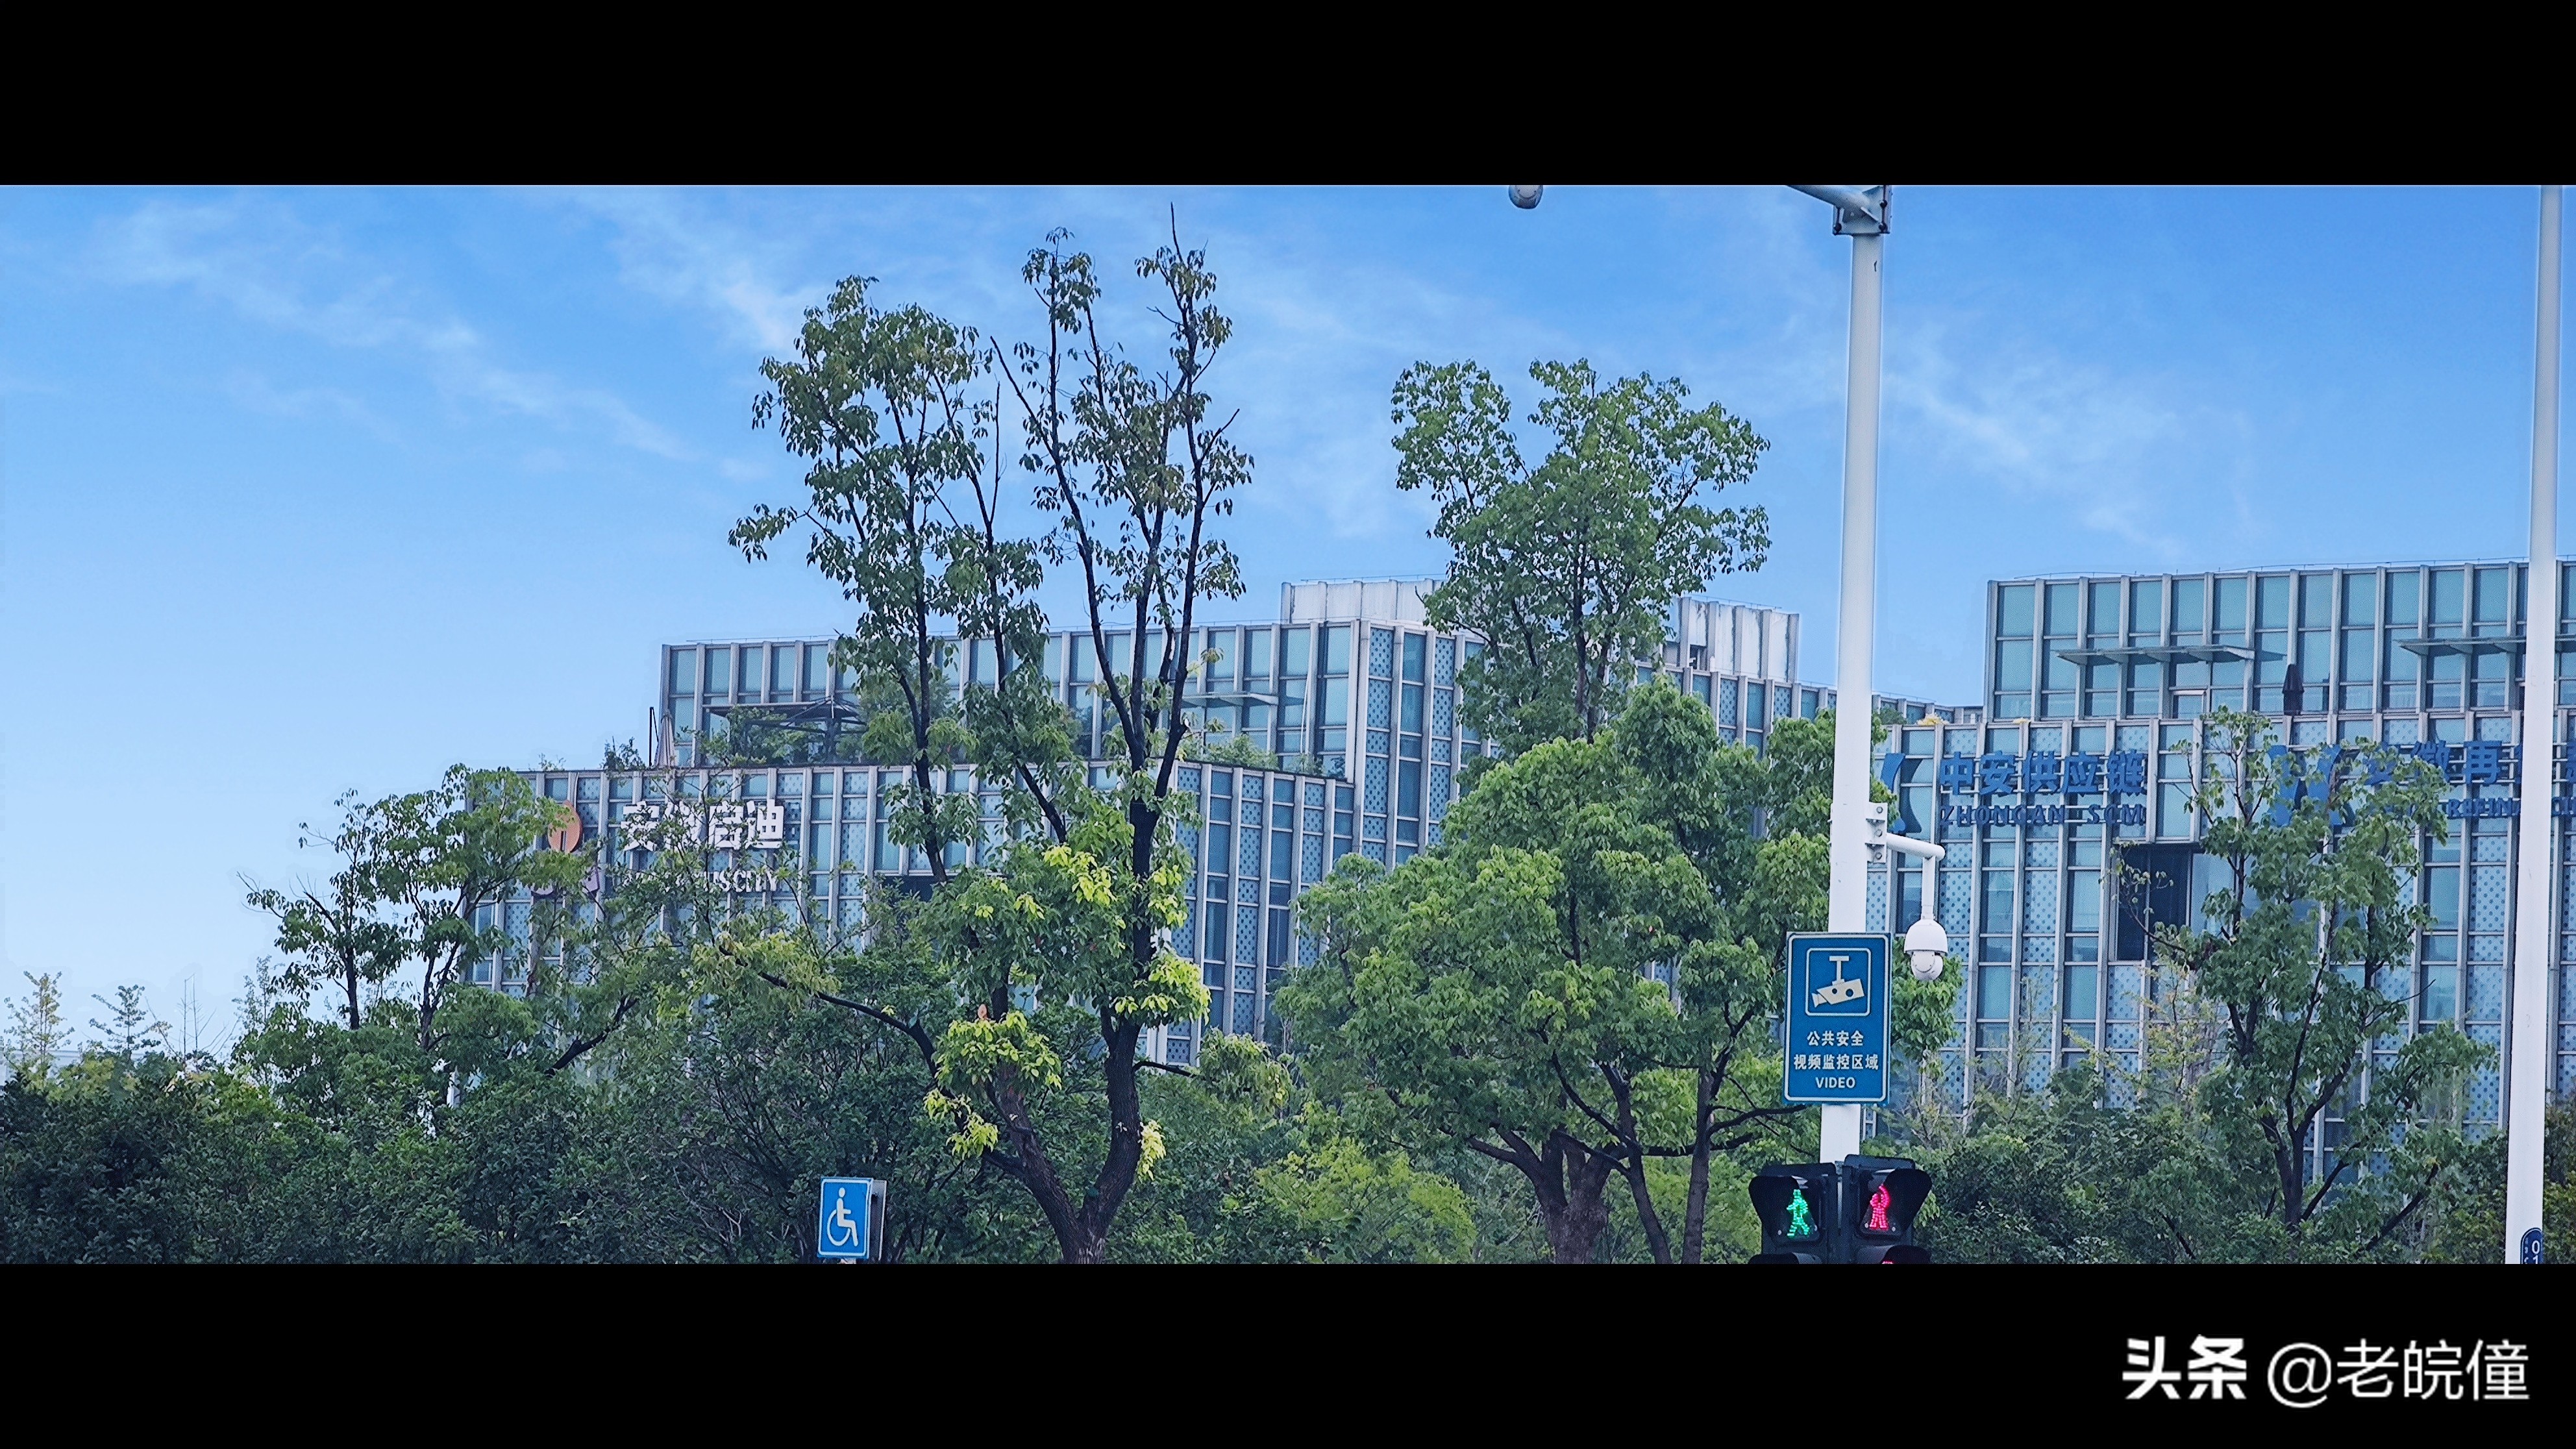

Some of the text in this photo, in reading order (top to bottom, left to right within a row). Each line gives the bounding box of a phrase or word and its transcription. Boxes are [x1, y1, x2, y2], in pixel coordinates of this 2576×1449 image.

[1940, 750, 2145, 797] 中安供应链
[1940, 803, 2146, 827] ZHONGAN SCM
[1807, 1030, 1864, 1046] 公共安全
[1794, 1054, 1879, 1070] 视频监控区域
[1815, 1076, 1855, 1089] VIDEO
